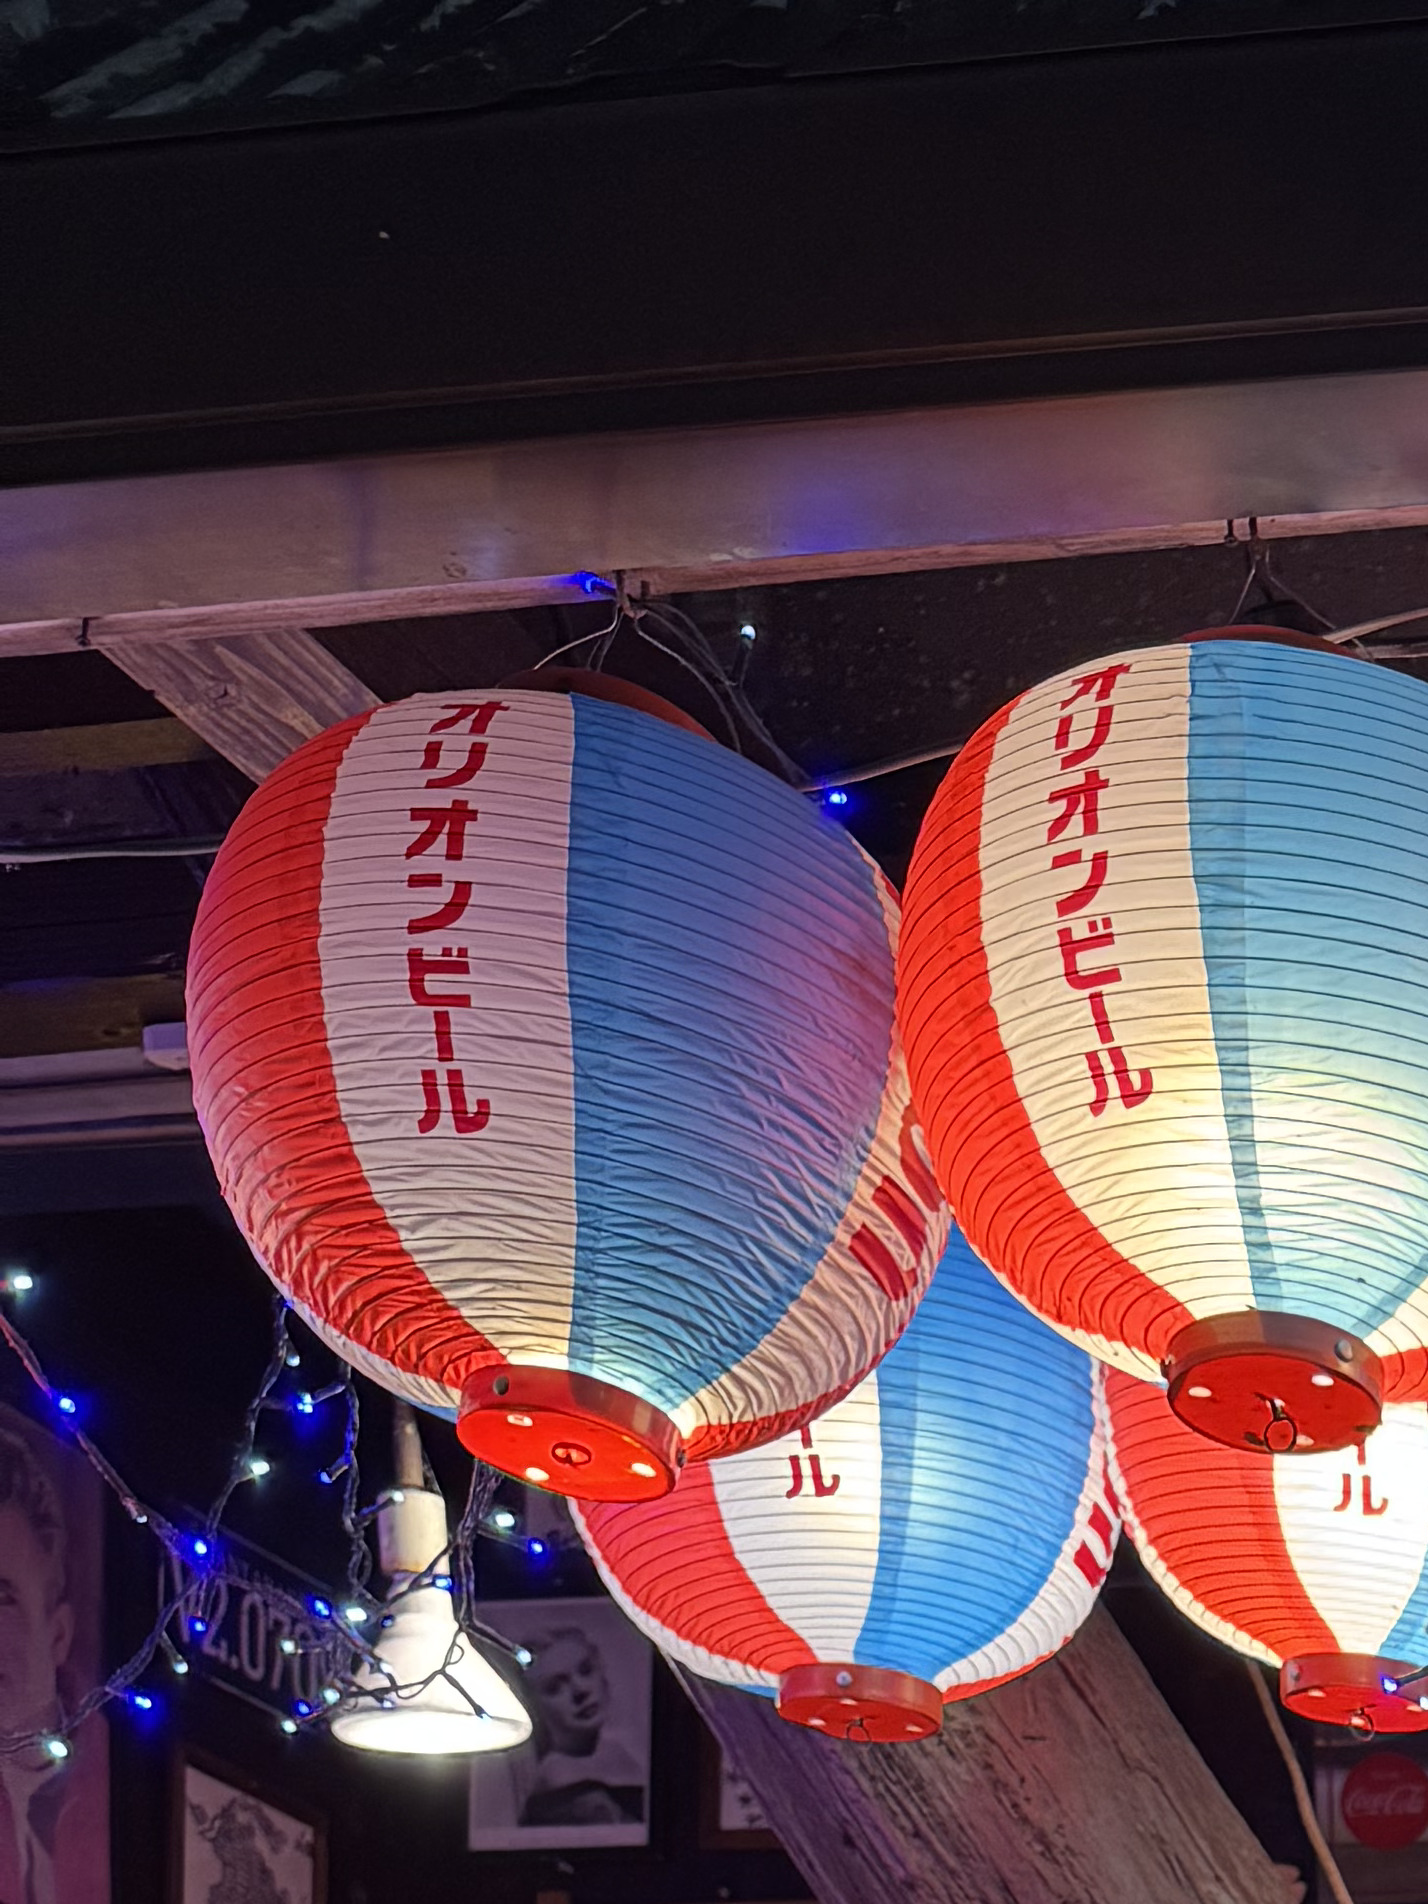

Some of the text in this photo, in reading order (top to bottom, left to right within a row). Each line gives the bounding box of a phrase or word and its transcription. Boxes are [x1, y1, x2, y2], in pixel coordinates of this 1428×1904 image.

[406, 700, 510, 1134] オリオンビール
[1046, 664, 1154, 1117] オリオンビール
